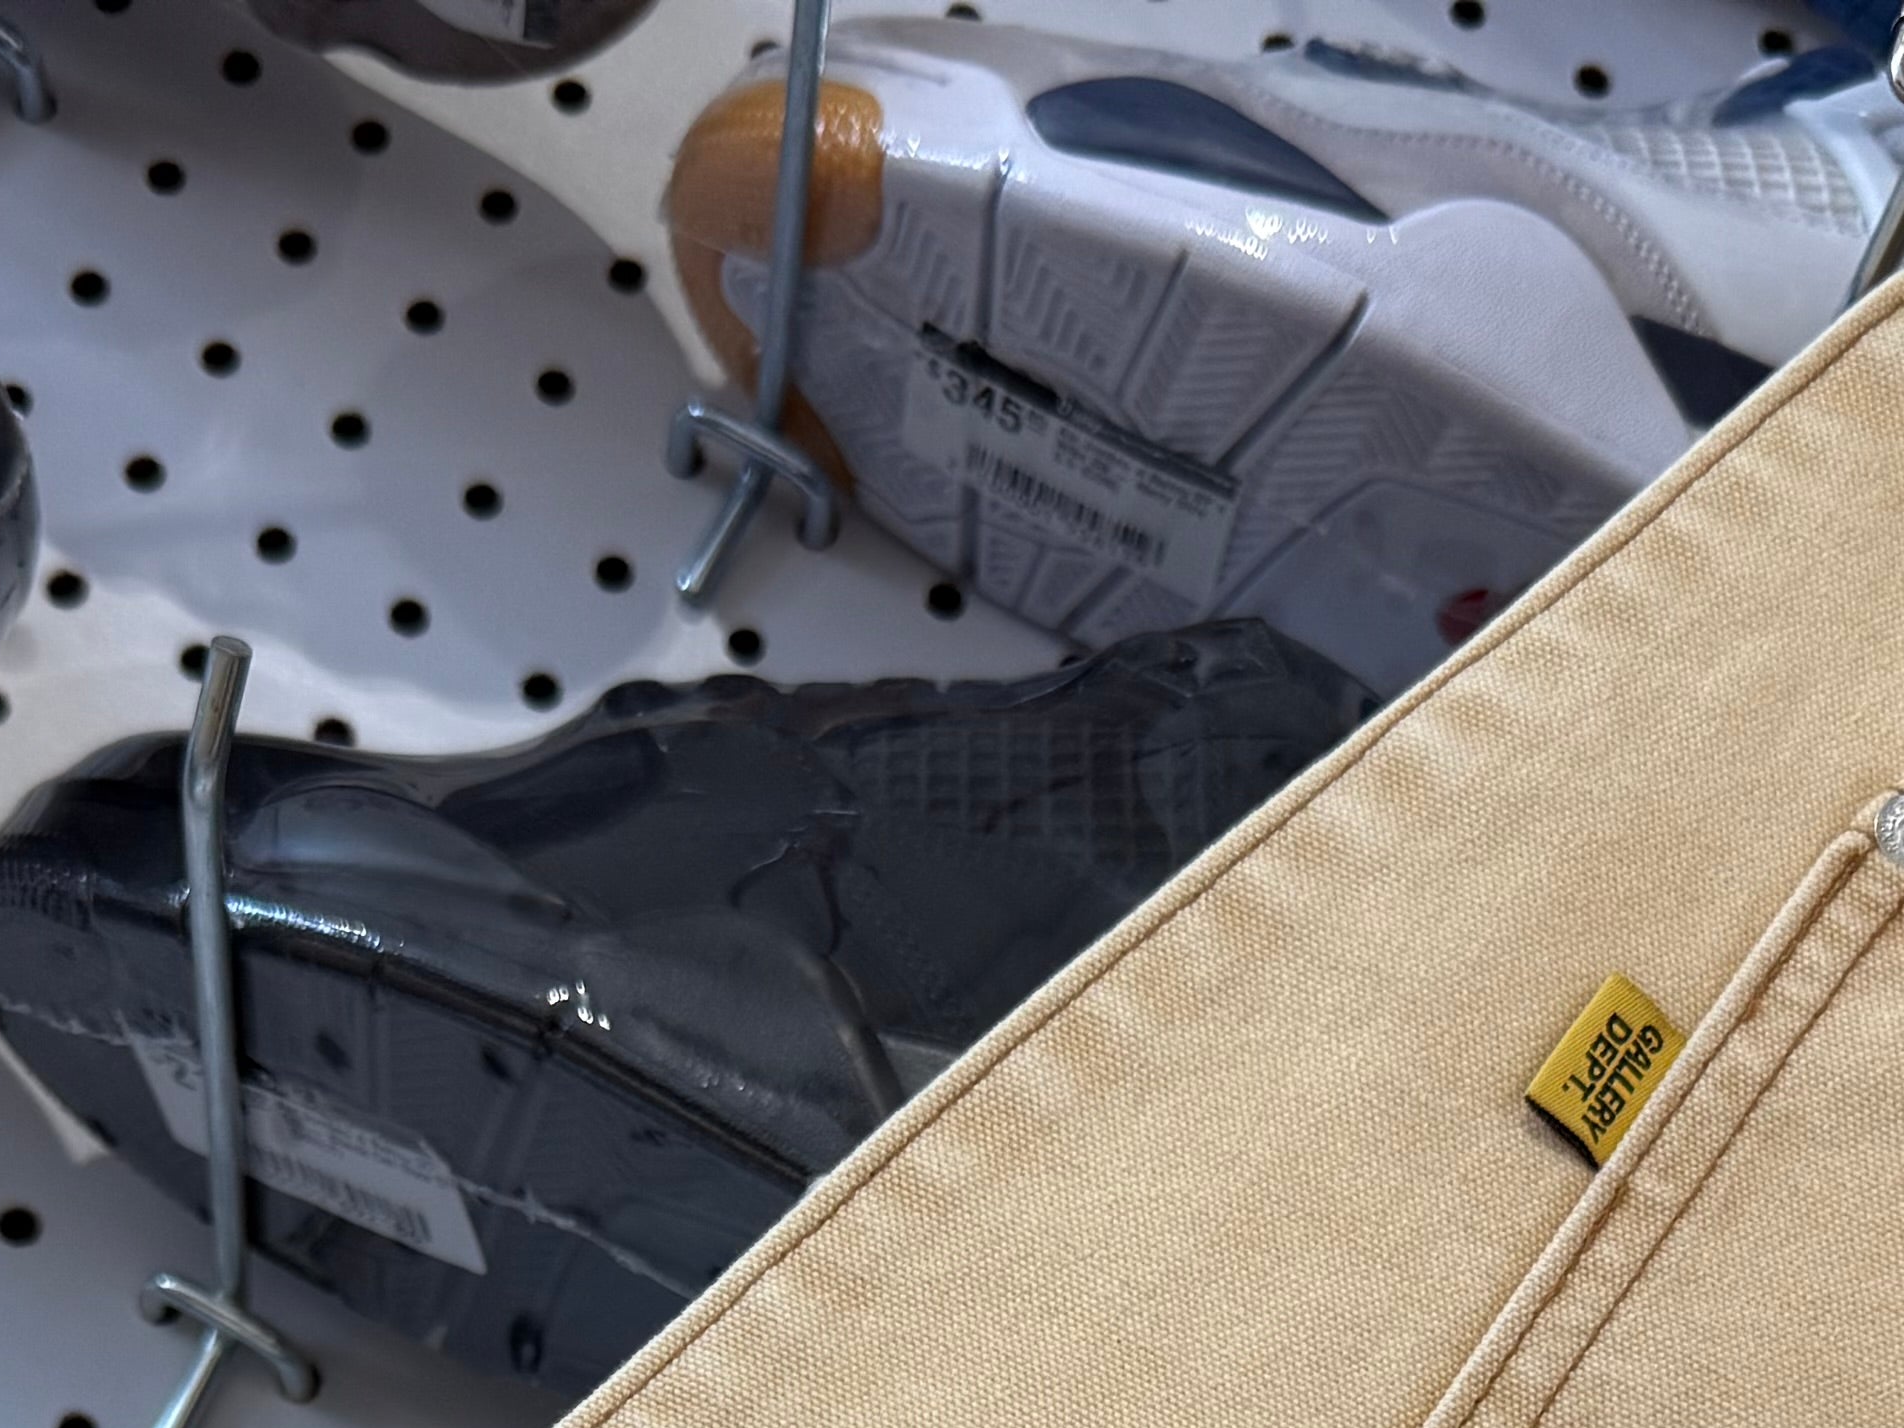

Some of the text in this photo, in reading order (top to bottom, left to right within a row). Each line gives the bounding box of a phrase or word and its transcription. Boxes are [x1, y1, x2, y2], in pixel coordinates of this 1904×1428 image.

[927, 358, 1023, 435] $345
[1561, 1012, 1634, 1102] DEPT.
[1580, 1024, 1664, 1145] GALLERY
